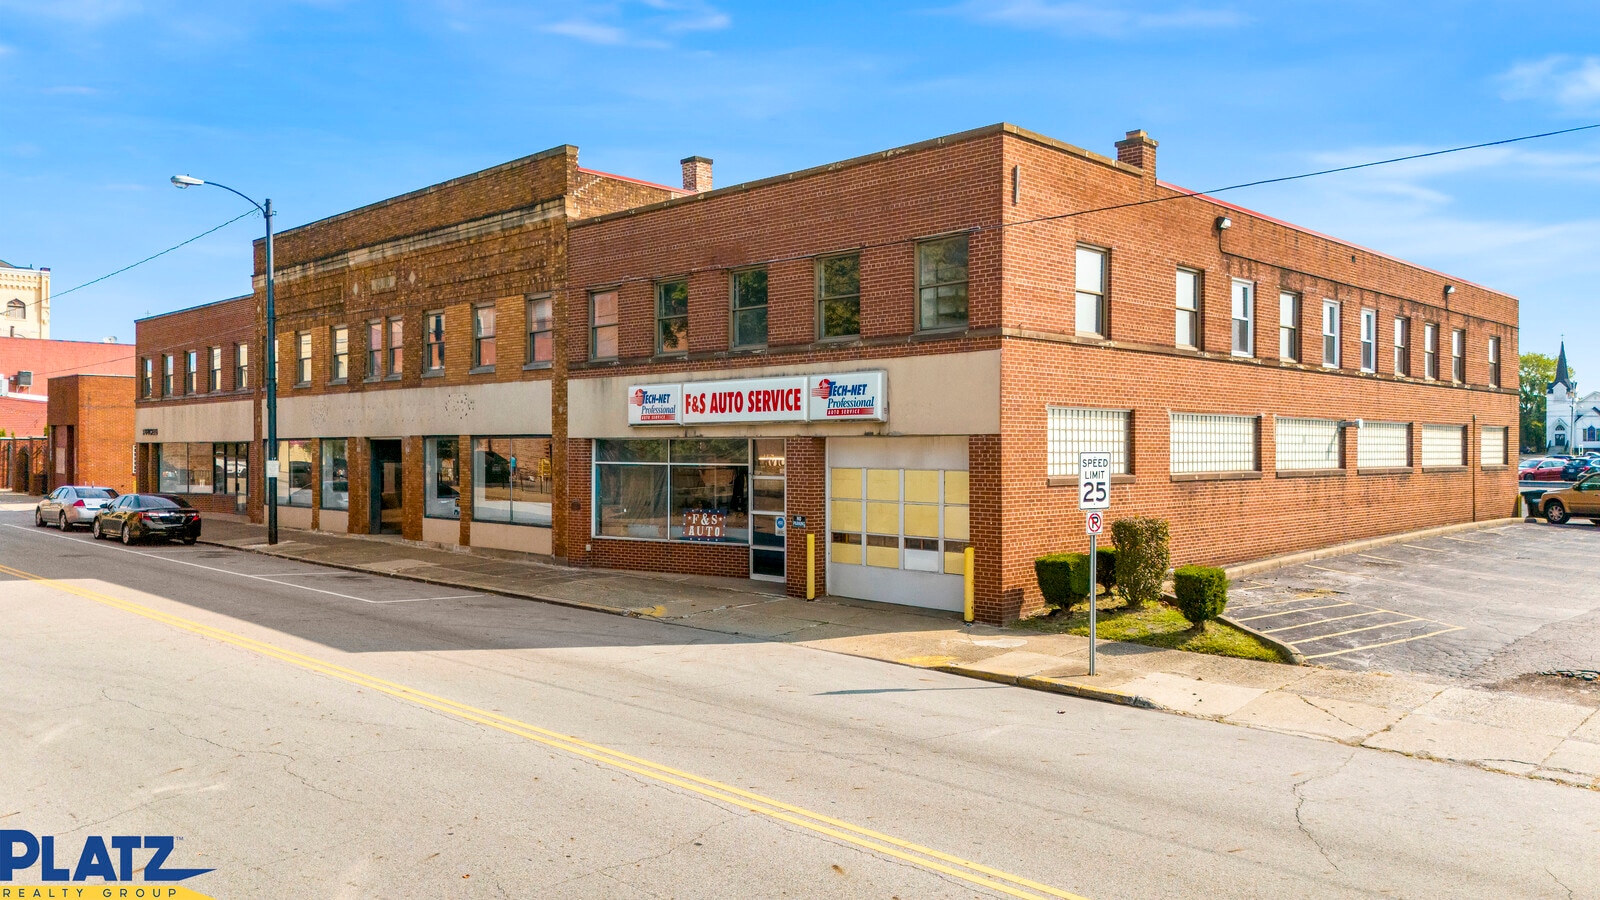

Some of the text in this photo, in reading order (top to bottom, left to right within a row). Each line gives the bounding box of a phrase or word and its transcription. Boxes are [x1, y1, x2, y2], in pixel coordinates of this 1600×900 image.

[685, 388, 801, 414] F&S AUTO SERVICE
[827, 396, 875, 408] Professional
[641, 405, 676, 414] Professional
[1082, 458, 1109, 468] SPEED
[1084, 470, 1105, 480] LIMIT
[1083, 481, 1107, 502] 25
[688, 525, 720, 537] AUTO
